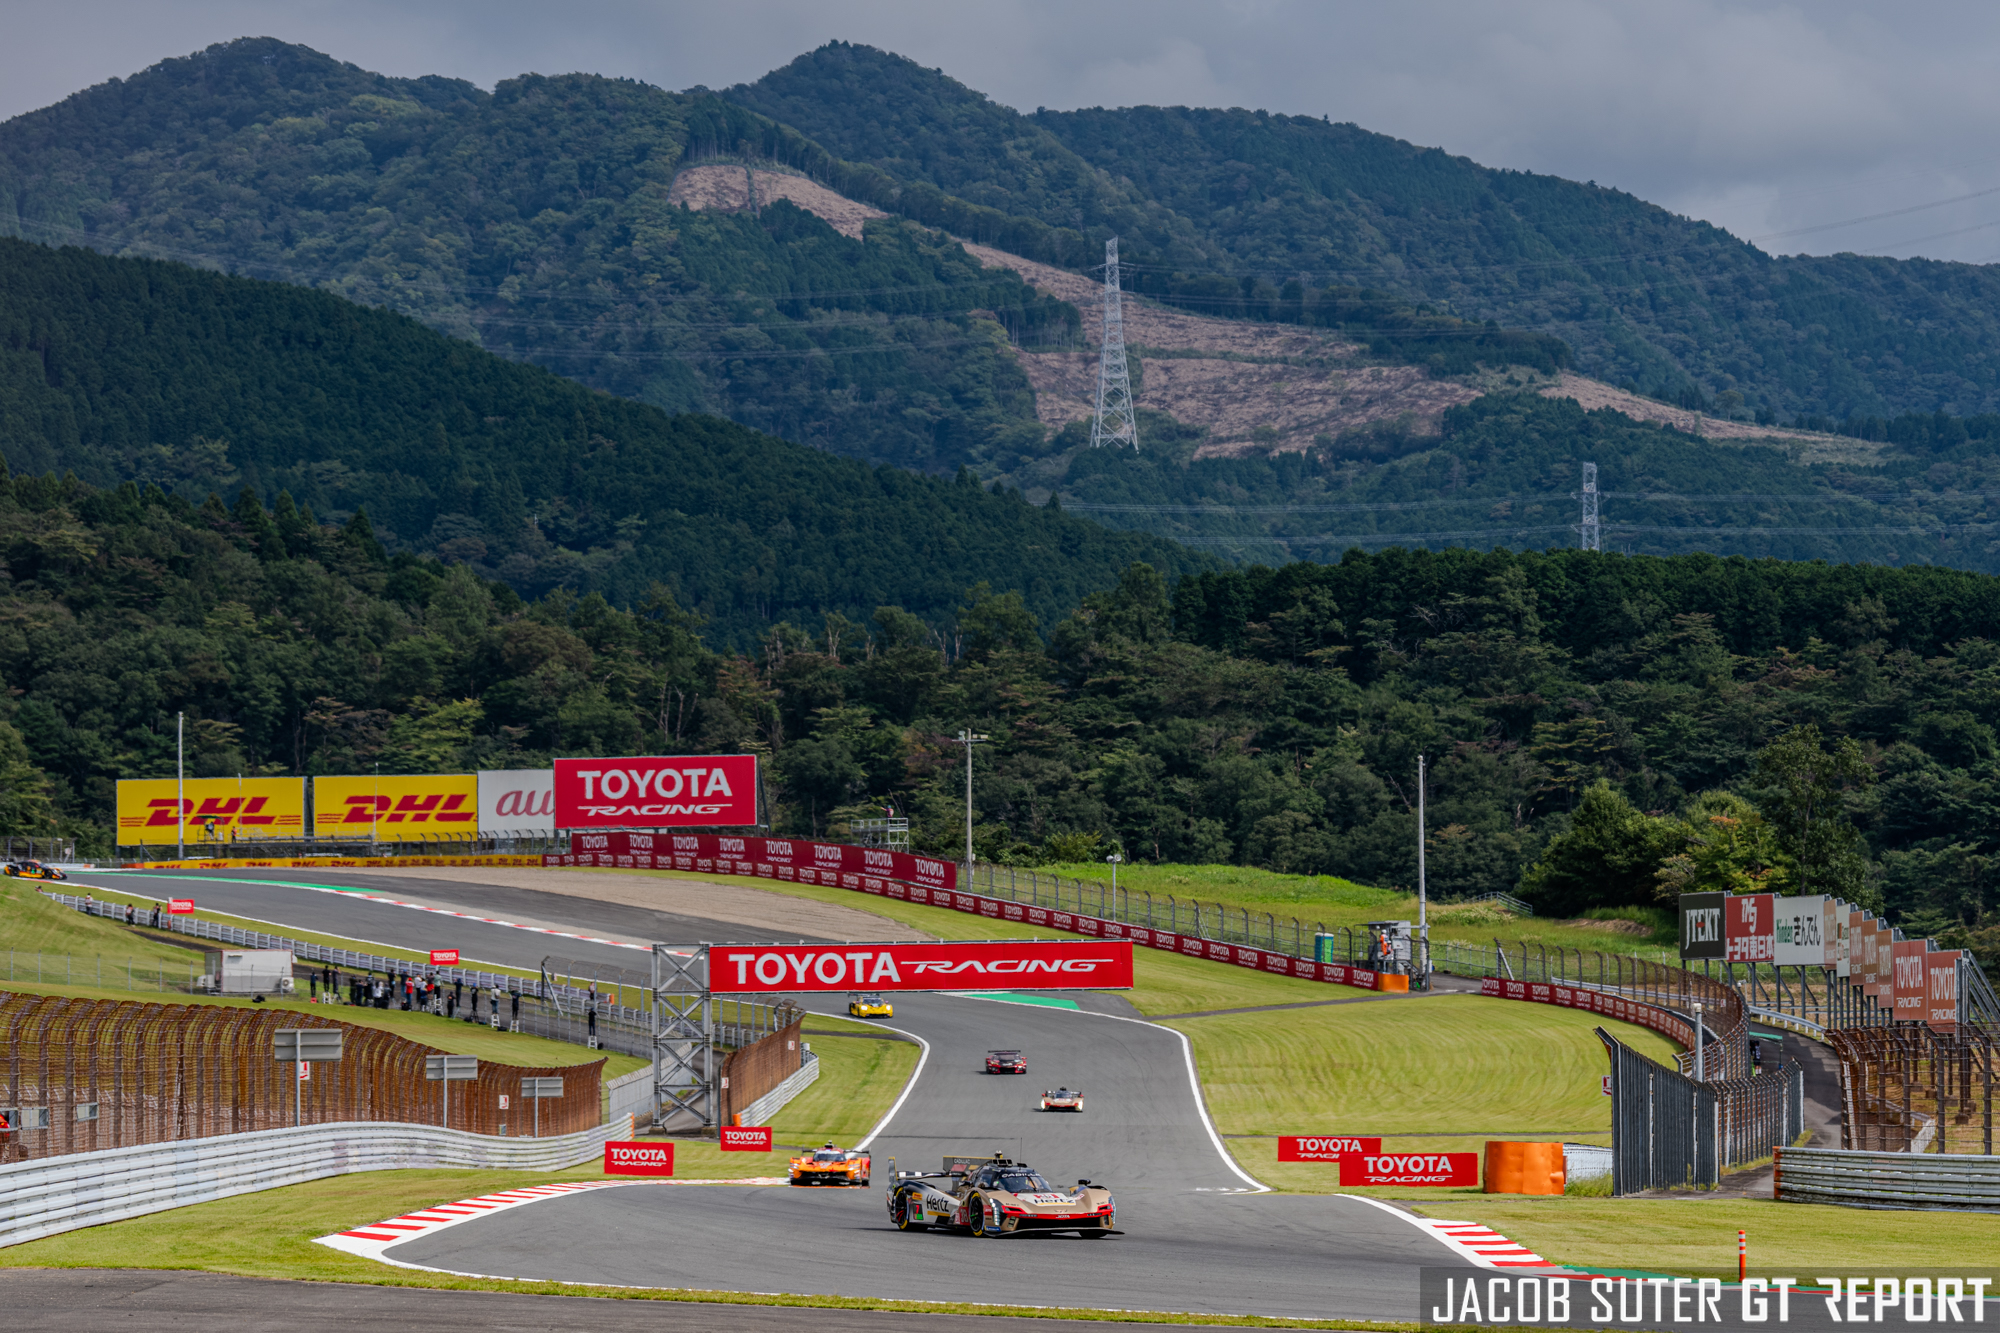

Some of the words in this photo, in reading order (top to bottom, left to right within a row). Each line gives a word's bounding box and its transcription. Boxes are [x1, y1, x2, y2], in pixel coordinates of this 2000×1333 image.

[577, 768, 733, 800] TOYOTA
[342, 794, 477, 823] DHL
[495, 790, 554, 816] au
[145, 797, 269, 826] DHL
[577, 804, 733, 816] RACING
[582, 835, 609, 848] TOYOTA
[629, 834, 654, 848] TOYOTA
[672, 836, 699, 850] TOYOTA
[719, 838, 746, 852] TOYOTA
[766, 840, 793, 856] TOYOTA
[814, 845, 842, 860] TOYOTA
[864, 850, 893, 868] TOYOTA
[864, 866, 893, 876] RACING
[915, 859, 945, 878] TOYOTA
[843, 874, 859, 885] TOYOTA
[865, 878, 882, 889] TOYOTA
[916, 874, 944, 885] RACING
[888, 882, 904, 893] TOYOTA
[910, 886, 927, 898] TOYOTA
[934, 891, 950, 902] TOYOTA
[956, 895, 974, 907] TOYOTA
[981, 900, 998, 912] TOYOTA
[1004, 904, 1023, 916] TOYOTA
[1029, 908, 1047, 920] TOYOTA
[1054, 912, 1072, 925] TOYOTA
[1078, 918, 1098, 930] TOYOTA
[1104, 924, 1122, 936] TOYOTA
[1685, 908, 1720, 950] JTEKT
[1794, 914, 1821, 946] きんでん
[1130, 928, 1150, 940] TOYOTA
[1156, 933, 1176, 946] TOYOTA
[1183, 938, 1202, 951] TOYOTA
[1210, 944, 1230, 956] TOYOTA
[1726, 933, 1774, 960] トヨタ東日本
[1238, 949, 1258, 962] TOYOTA
[1266, 955, 1288, 968] TOYOTA
[728, 951, 901, 985] TOYOTA
[901, 959, 1114, 974] RACING
[1295, 961, 1316, 974] TOYOTA
[1324, 966, 1345, 978] TOYOTA
[1896, 956, 1924, 990] TOYOTA
[1353, 970, 1374, 982] TOYOTA
[1506, 982, 1525, 994] TOYOTA
[1532, 984, 1550, 996] TOYOTA
[1896, 996, 1924, 1008] RACING
[725, 1131, 767, 1140] TOYOTA
[1296, 1138, 1363, 1152] TOYOTA
[611, 1148, 667, 1161] TOYOTA
[1364, 1156, 1453, 1173] TOYOTA
[926, 1194, 950, 1212] Hertz
